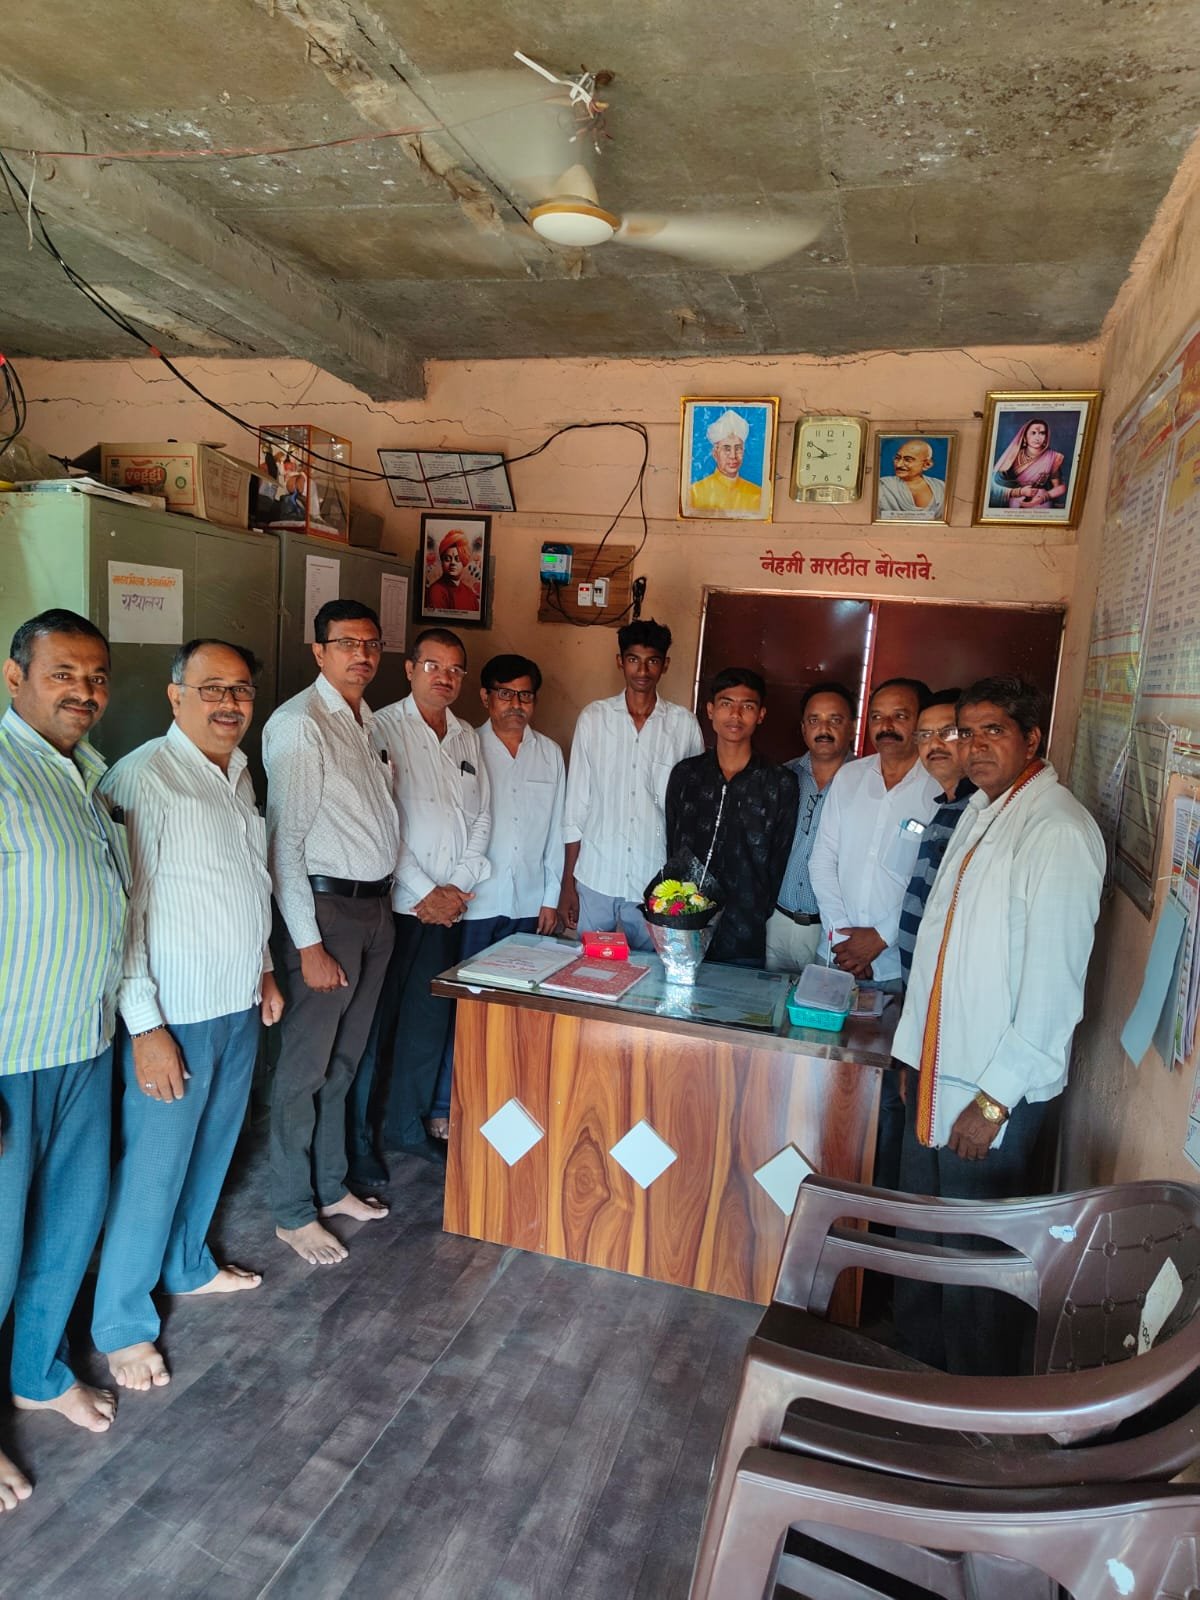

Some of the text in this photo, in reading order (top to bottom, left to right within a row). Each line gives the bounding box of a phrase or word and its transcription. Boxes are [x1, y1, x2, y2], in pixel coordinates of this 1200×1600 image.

[760, 550, 936, 580] नेहमी मराठीत बोलावे.
